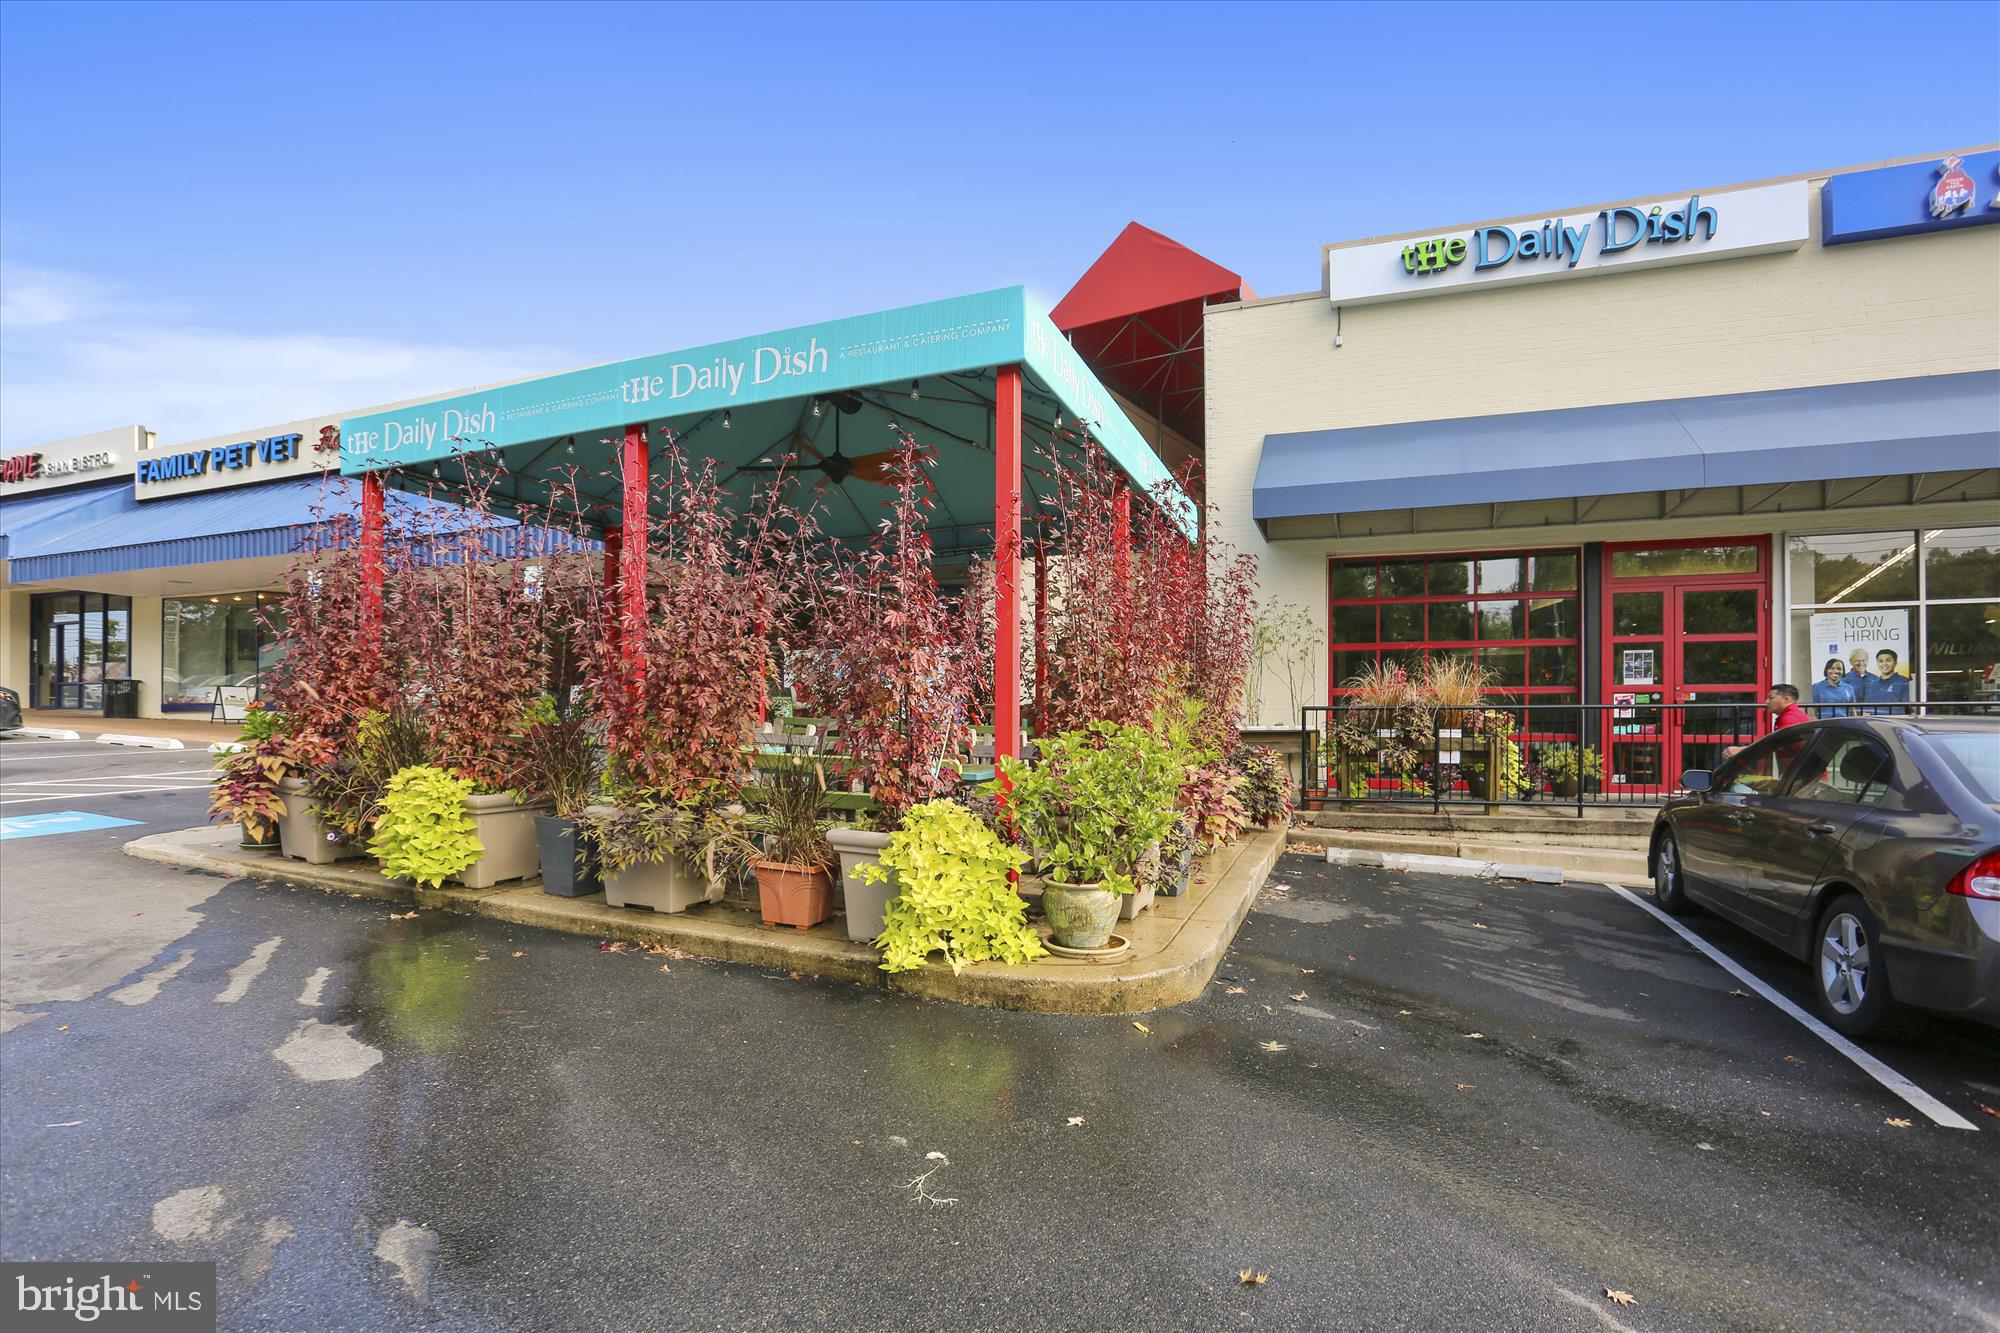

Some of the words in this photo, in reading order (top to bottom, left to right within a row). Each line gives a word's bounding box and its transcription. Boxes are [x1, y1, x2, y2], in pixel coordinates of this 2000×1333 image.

[1474, 219, 1591, 270] Daily
[1598, 195, 1718, 254] Dish
[848, 342, 900, 358] RESTAURANT
[913, 333, 958, 347] CATERING
[961, 323, 1011, 338] COMPANY
[669, 357, 745, 399] Daily
[751, 337, 828, 385] Dish
[384, 417, 437, 452] Daily
[441, 401, 495, 442] Dish
[137, 450, 210, 483] FAMILY
[211, 442, 256, 471] PET
[256, 433, 303, 463] VET
[1844, 616, 1884, 629] NOW
[1844, 628, 1900, 642] HIRING
